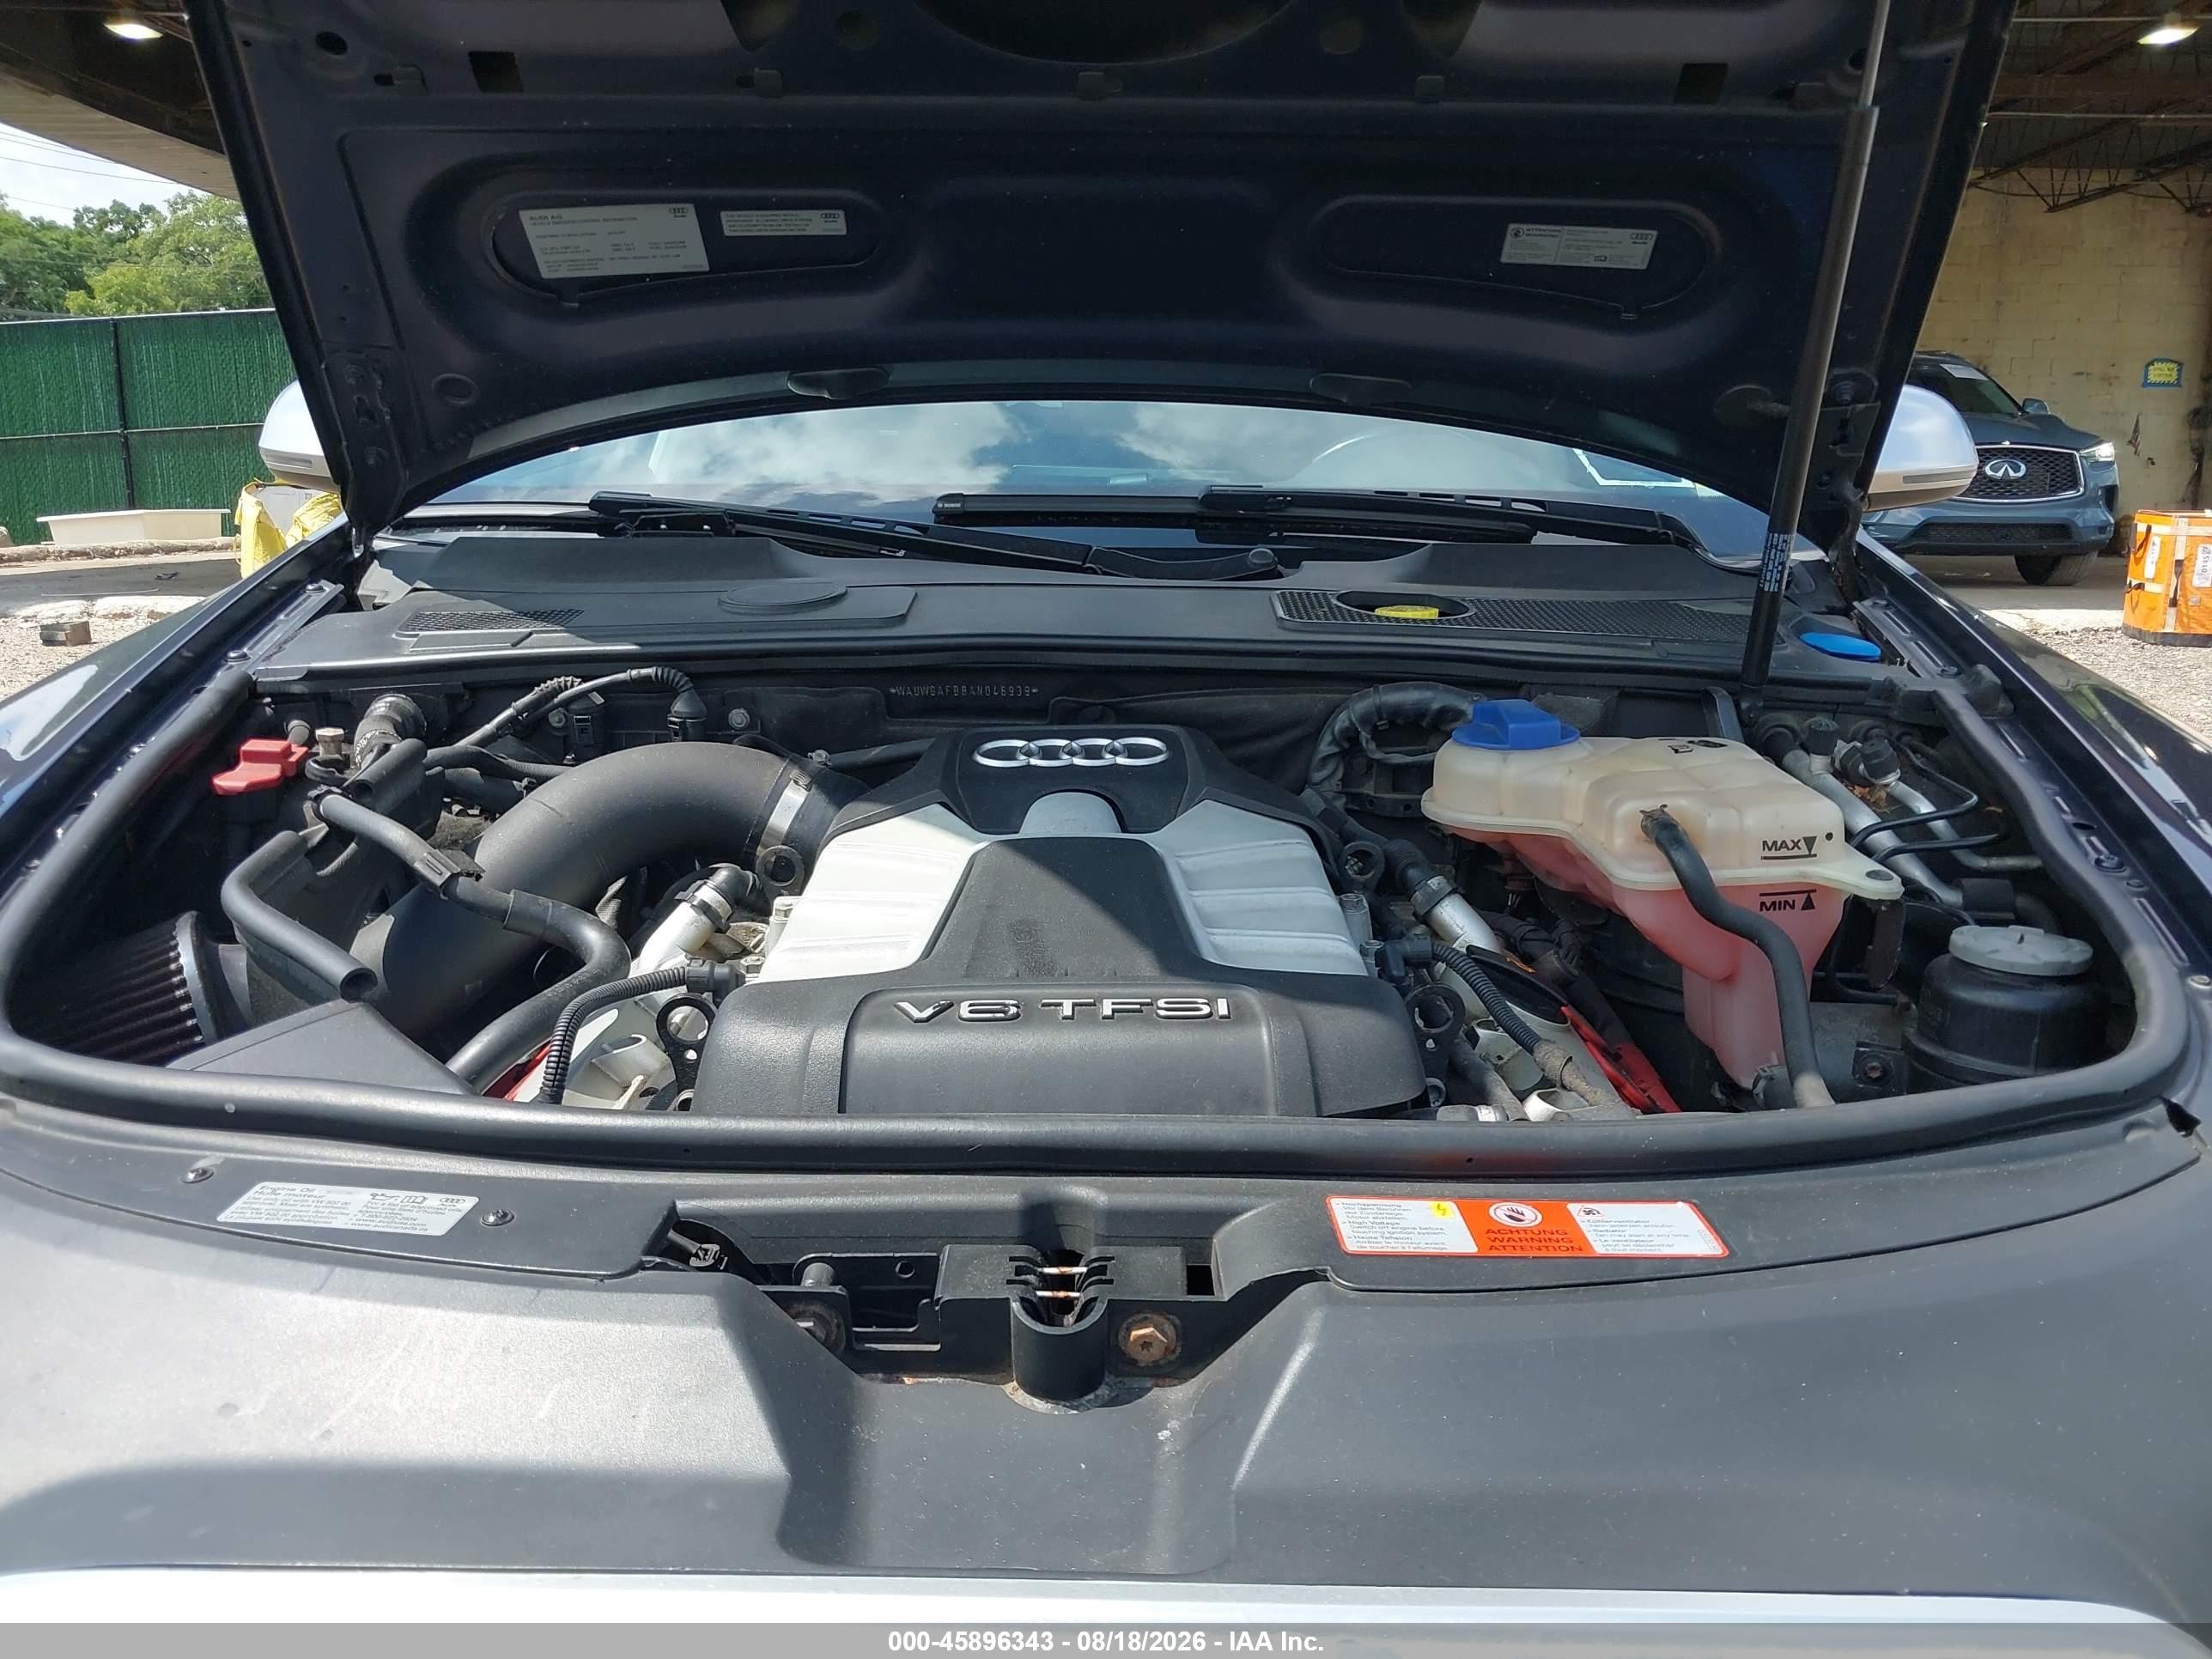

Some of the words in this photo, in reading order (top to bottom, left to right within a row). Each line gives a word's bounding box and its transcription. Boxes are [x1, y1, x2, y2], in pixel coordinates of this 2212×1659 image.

[1762, 839, 1802, 851] MAX
[1759, 899, 1795, 912] MIN
[894, 999, 1022, 1023] V6
[1040, 997, 1231, 1020] TFSI
[259, 1185, 296, 1194] Engine
